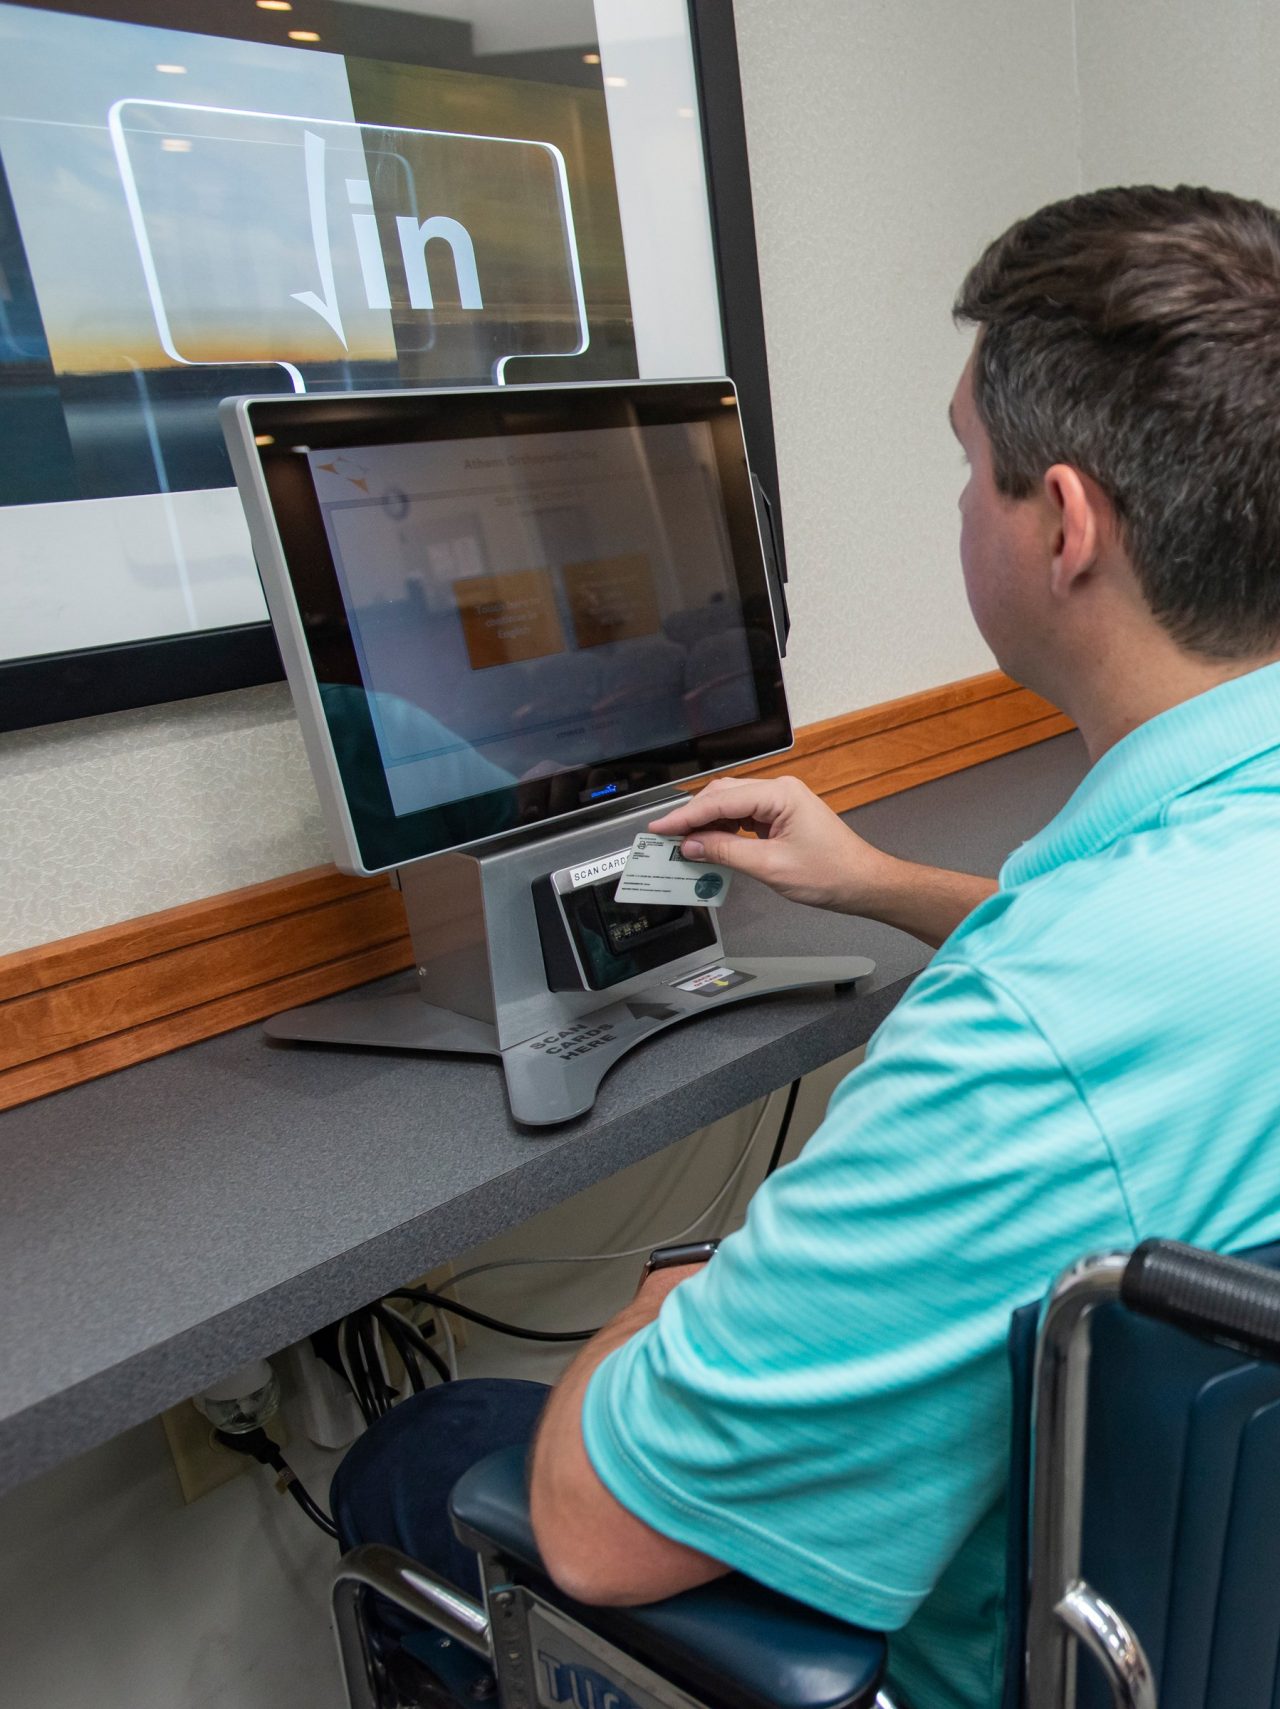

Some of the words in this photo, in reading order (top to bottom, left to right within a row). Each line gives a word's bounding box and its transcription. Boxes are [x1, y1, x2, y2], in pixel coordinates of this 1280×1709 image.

[574, 866, 599, 881] SCAN
[529, 1023, 588, 1050] SCAN
[545, 1023, 615, 1055] CARDS
[559, 1034, 617, 1060] HERE
